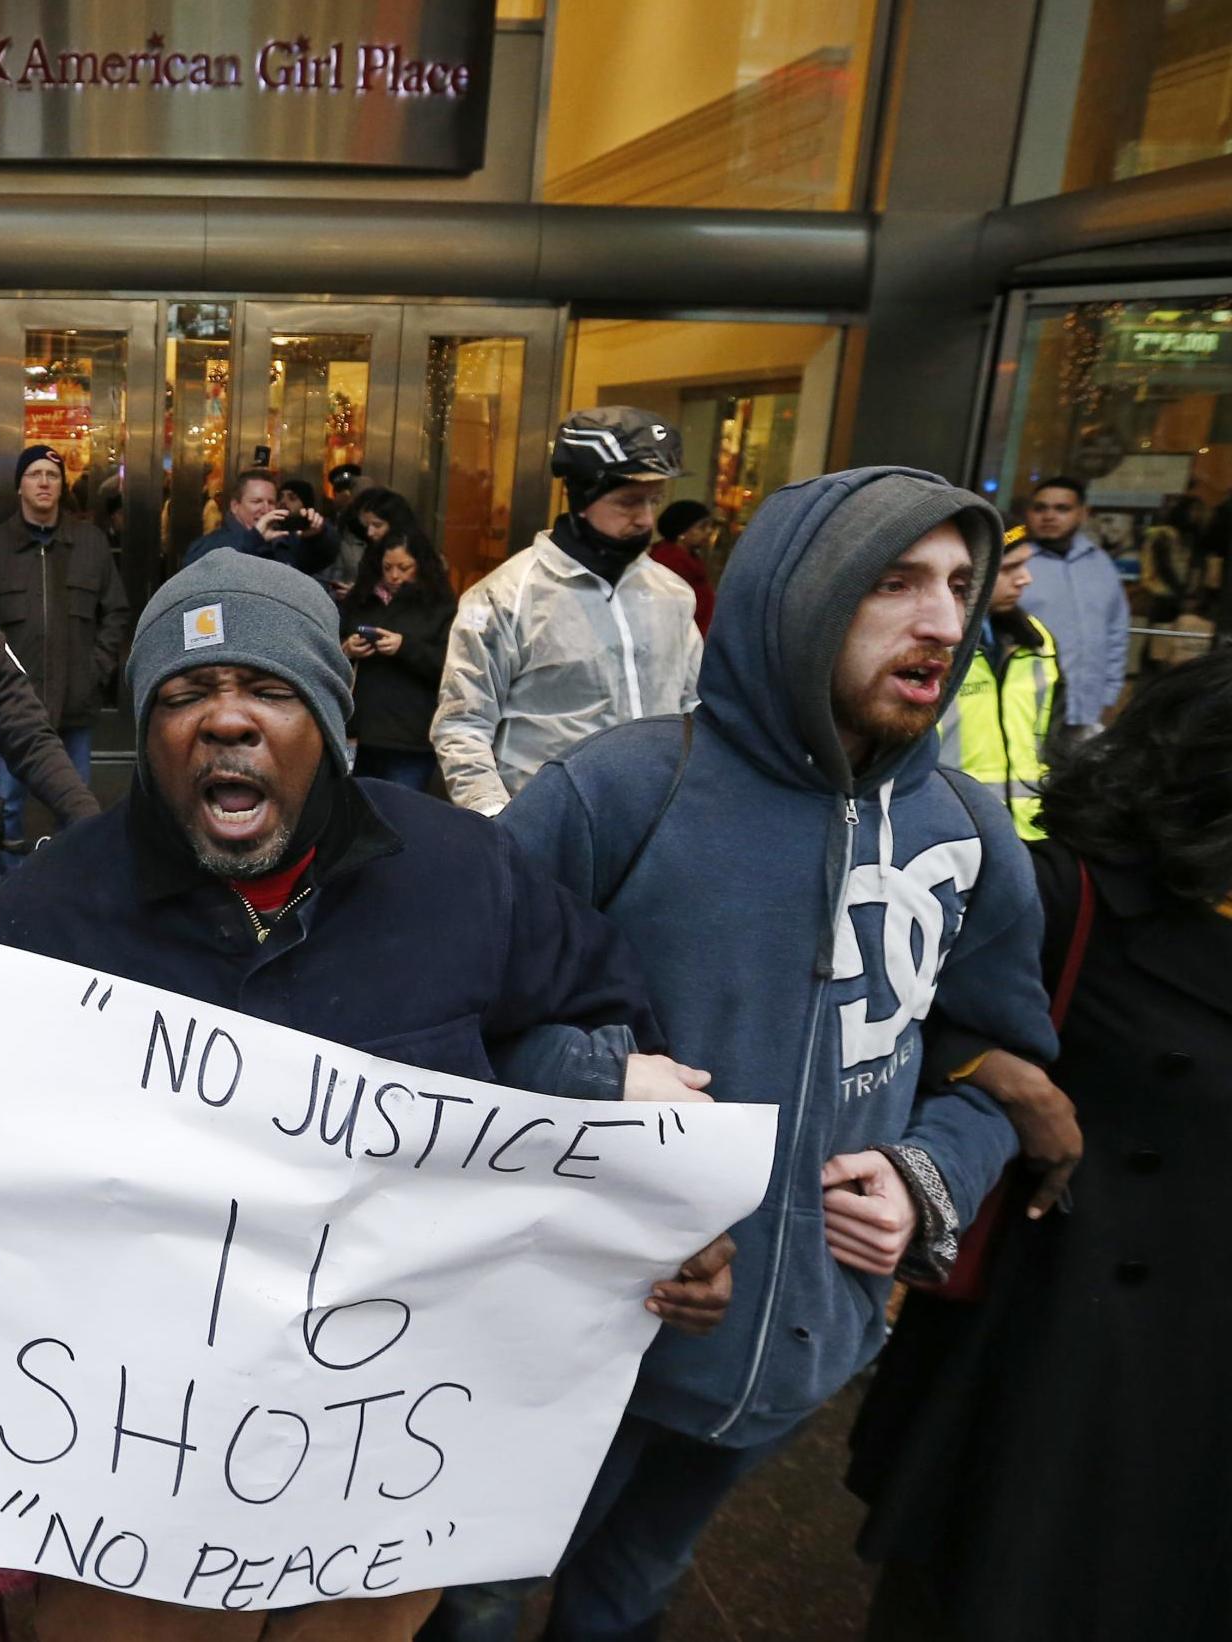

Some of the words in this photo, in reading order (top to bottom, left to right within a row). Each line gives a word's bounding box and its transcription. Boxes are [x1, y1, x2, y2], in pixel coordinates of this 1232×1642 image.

[17, 31, 243, 88] American
[256, 34, 344, 91] Girl
[356, 43, 470, 96] Place
